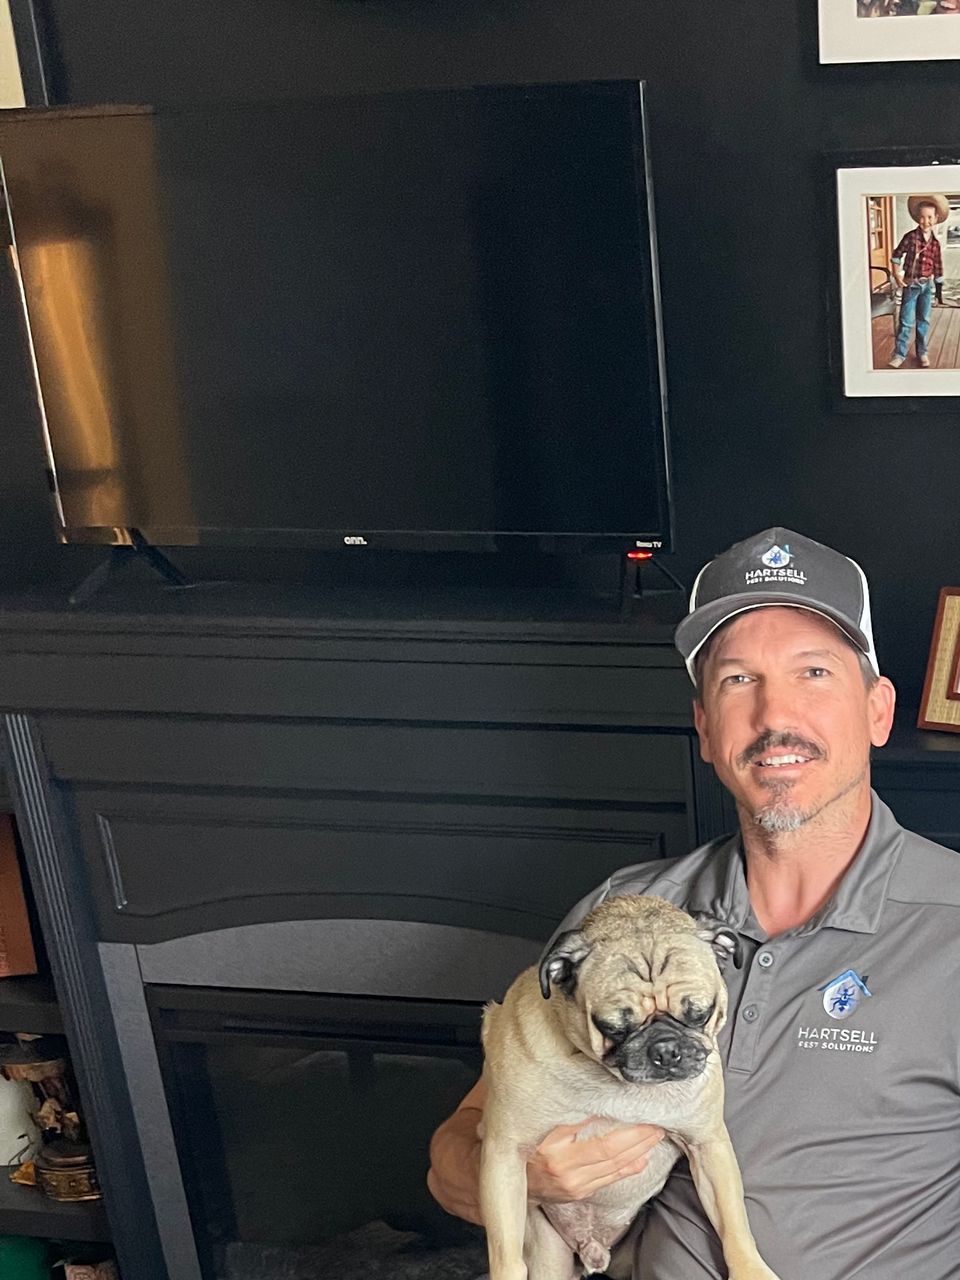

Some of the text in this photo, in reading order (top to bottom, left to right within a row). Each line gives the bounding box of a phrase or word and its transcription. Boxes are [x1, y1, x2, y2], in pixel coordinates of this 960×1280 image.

[745, 568, 808, 581] HARTSELL
[798, 1027, 877, 1044] HARTSELL
[821, 1042, 874, 1053] SOLUTIONS
